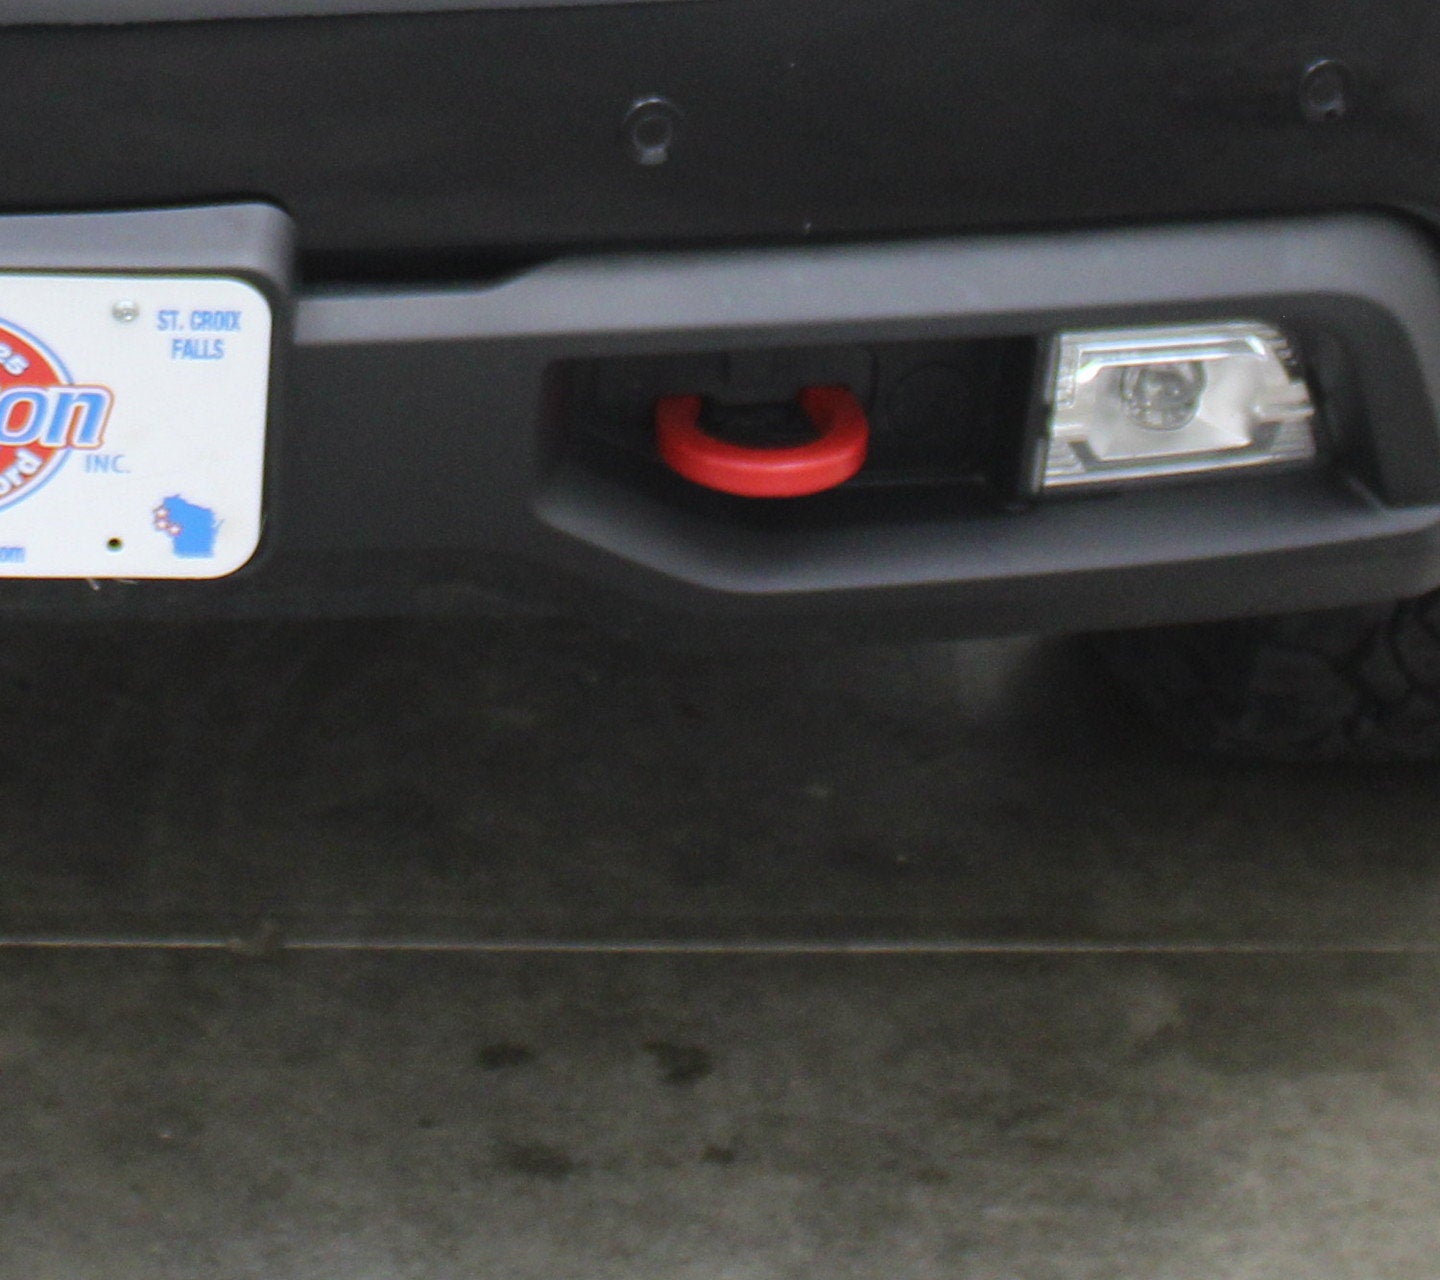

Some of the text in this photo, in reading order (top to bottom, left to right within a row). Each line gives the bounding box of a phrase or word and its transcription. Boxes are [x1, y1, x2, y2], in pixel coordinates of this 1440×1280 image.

[158, 309, 241, 331] ST. CROIX
[172, 339, 224, 360] FALLS
[85, 455, 131, 474] INC.
